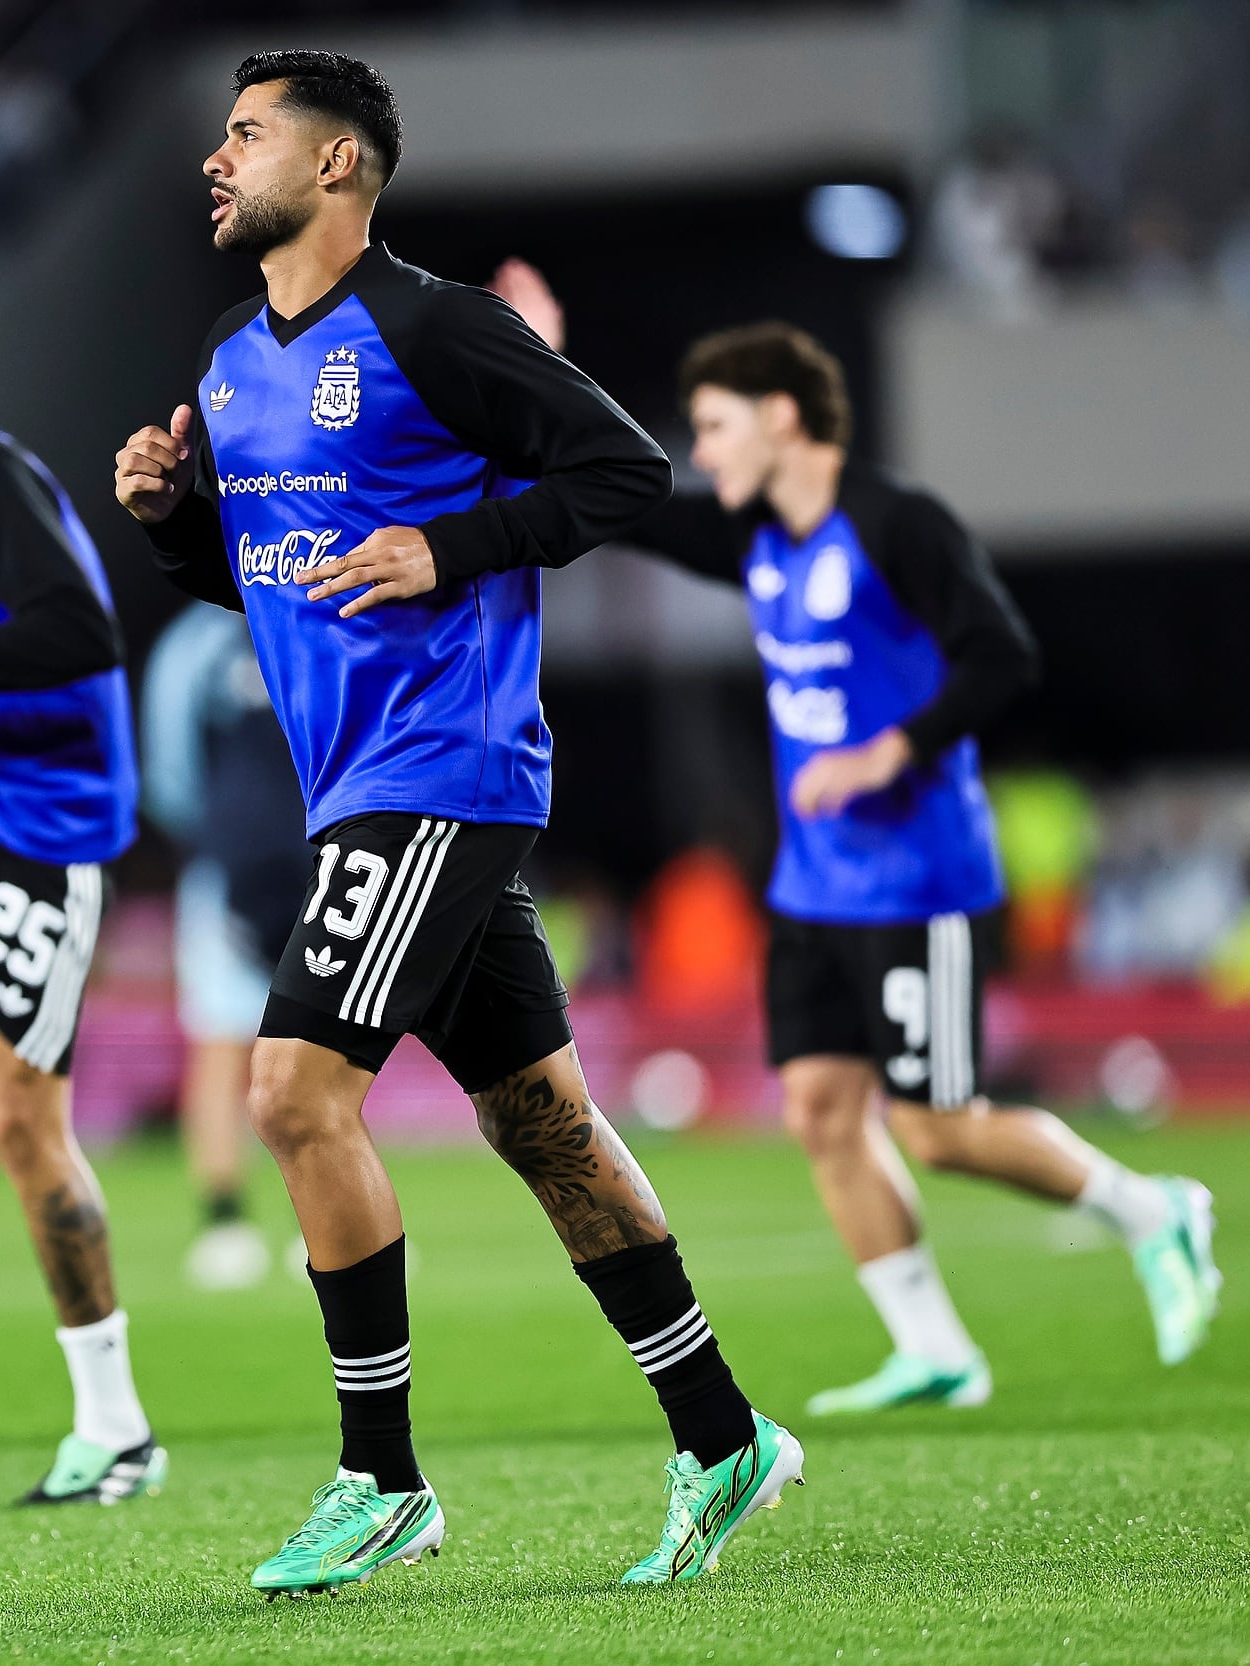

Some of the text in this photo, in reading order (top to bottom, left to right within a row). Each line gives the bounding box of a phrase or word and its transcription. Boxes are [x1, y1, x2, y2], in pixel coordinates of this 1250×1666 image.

[323, 383, 348, 411] AFA
[228, 470, 347, 497] Google Gemini
[303, 843, 390, 941] 13
[883, 966, 928, 1050] 9
